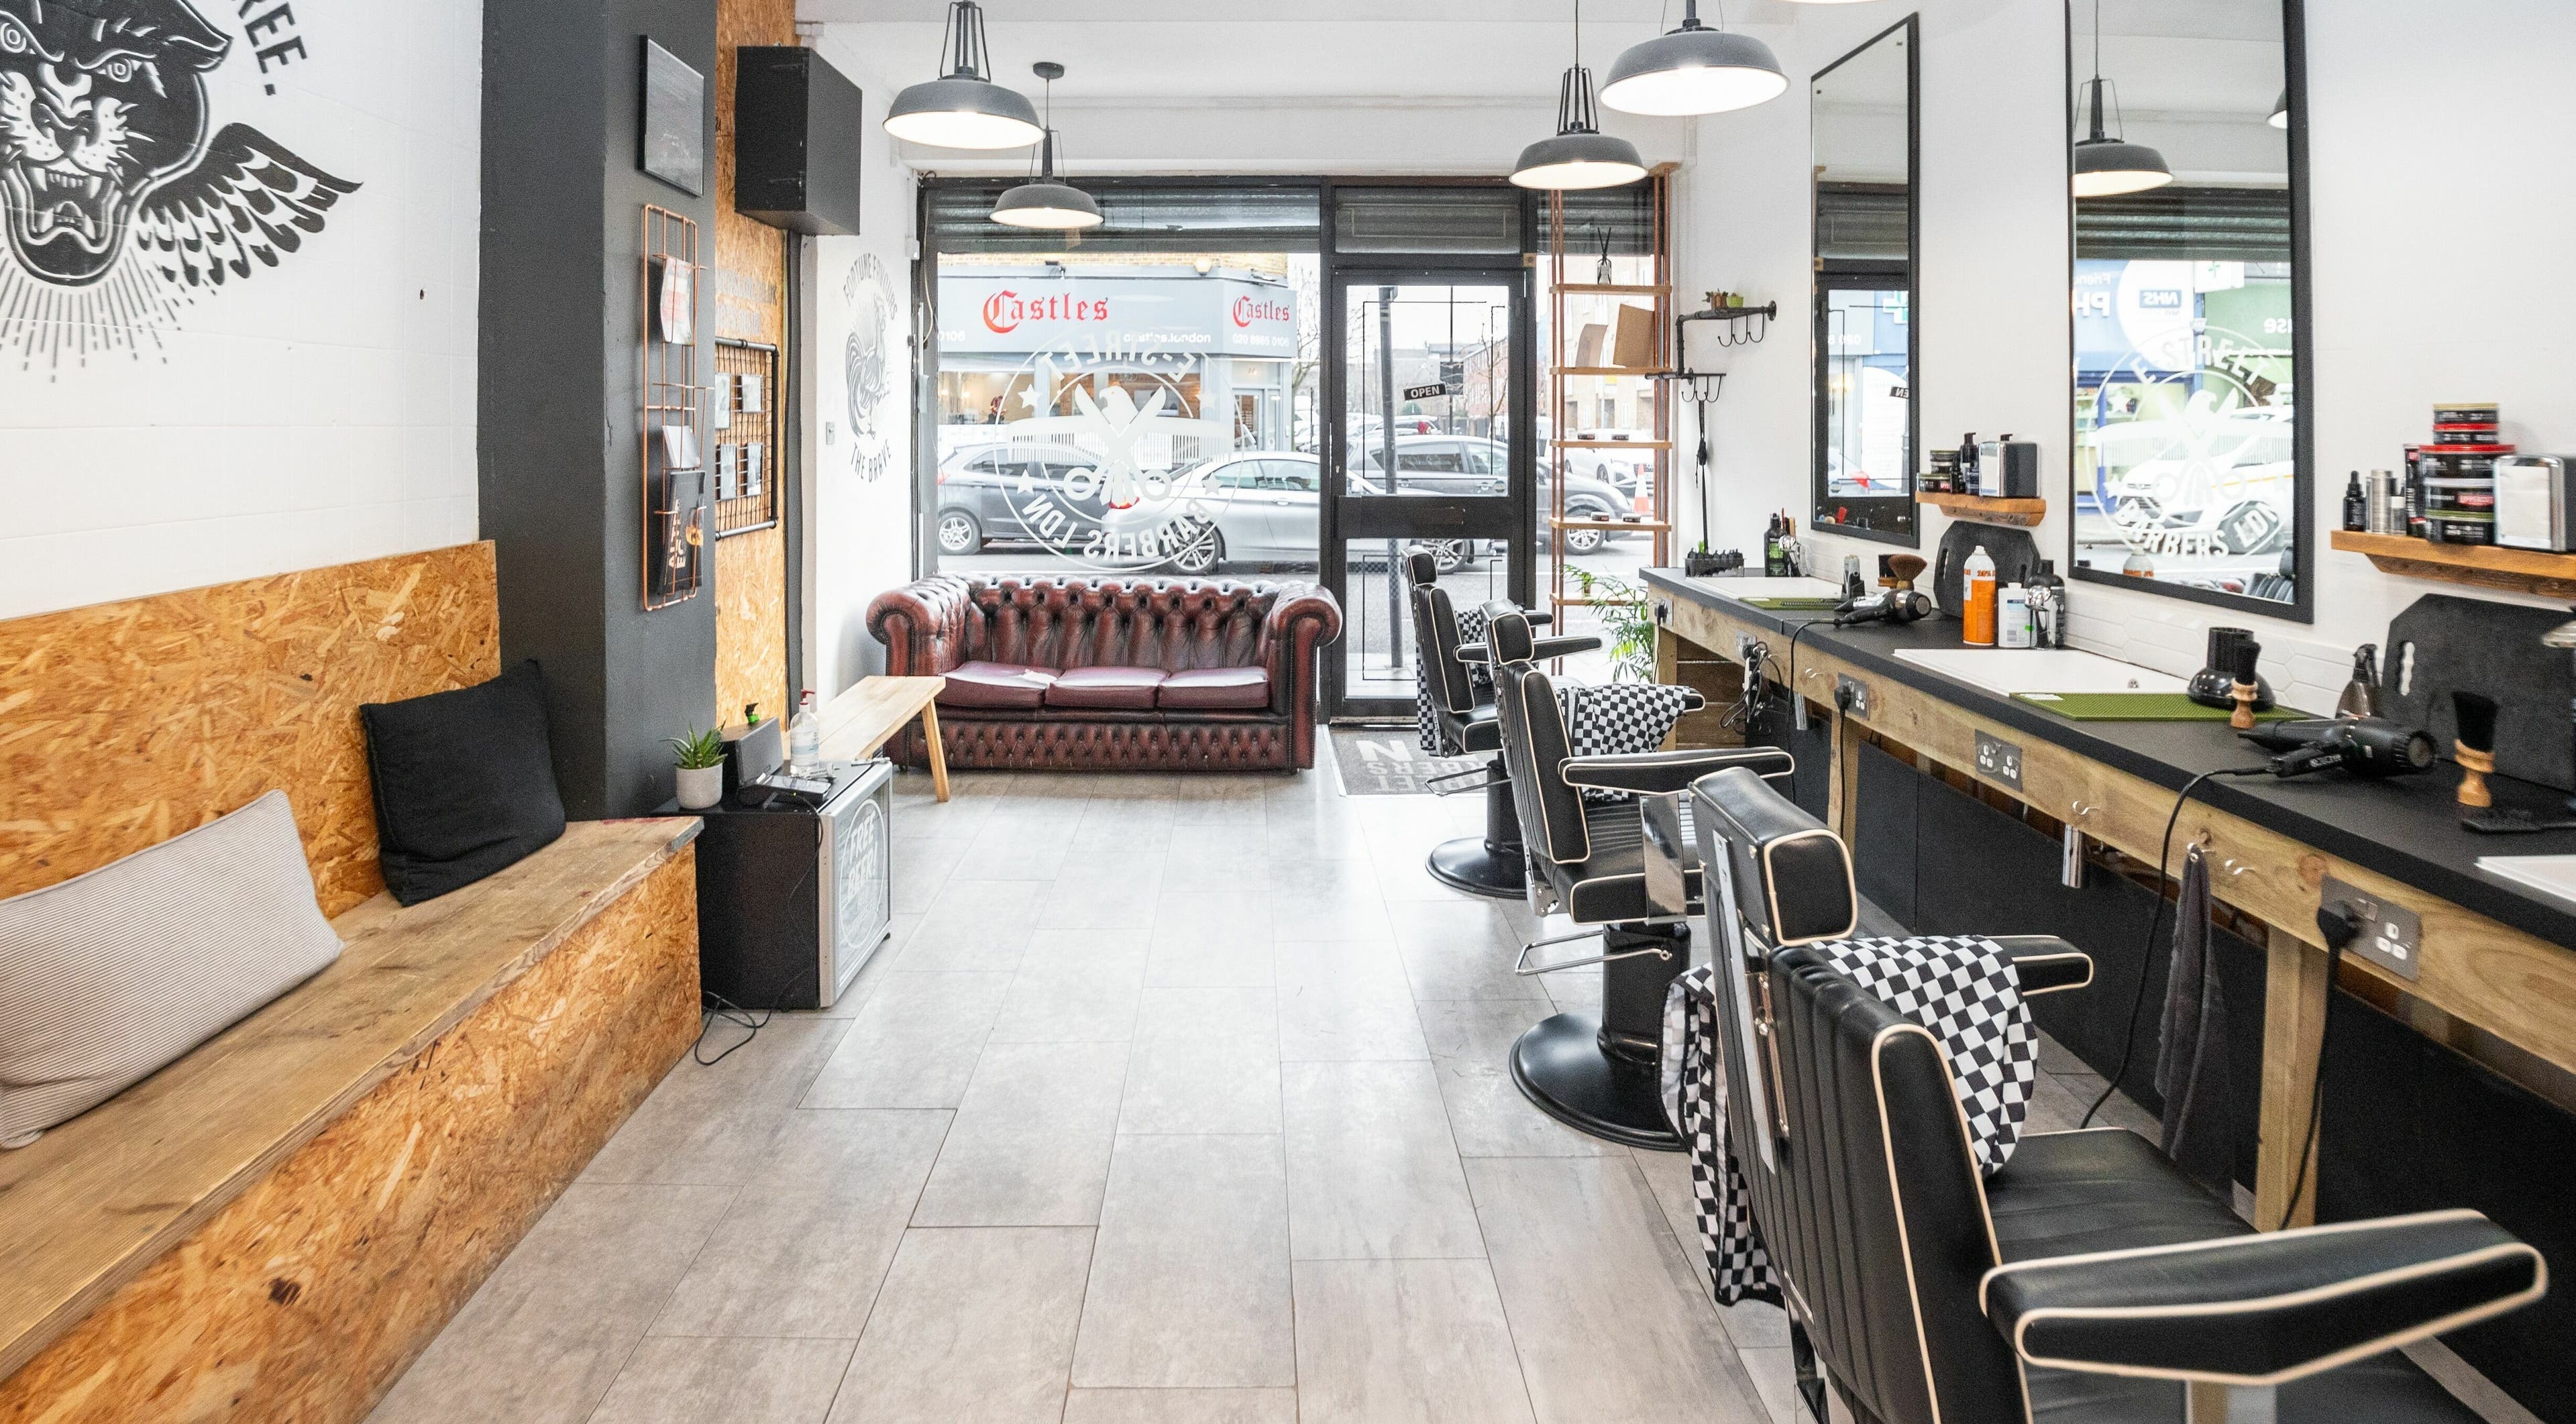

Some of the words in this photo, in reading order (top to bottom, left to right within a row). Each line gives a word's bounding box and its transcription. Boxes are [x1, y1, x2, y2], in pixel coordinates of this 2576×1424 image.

[843, 252, 872, 307] FORTUNE
[983, 290, 1108, 333] Castles
[1233, 295, 1290, 327] Castles
[1232, 333, 1248, 344] 020
[1410, 385, 1440, 398] OPEN
[851, 441, 865, 480] THE
[869, 438, 892, 483] BRAVE
[849, 810, 876, 865] FREE
